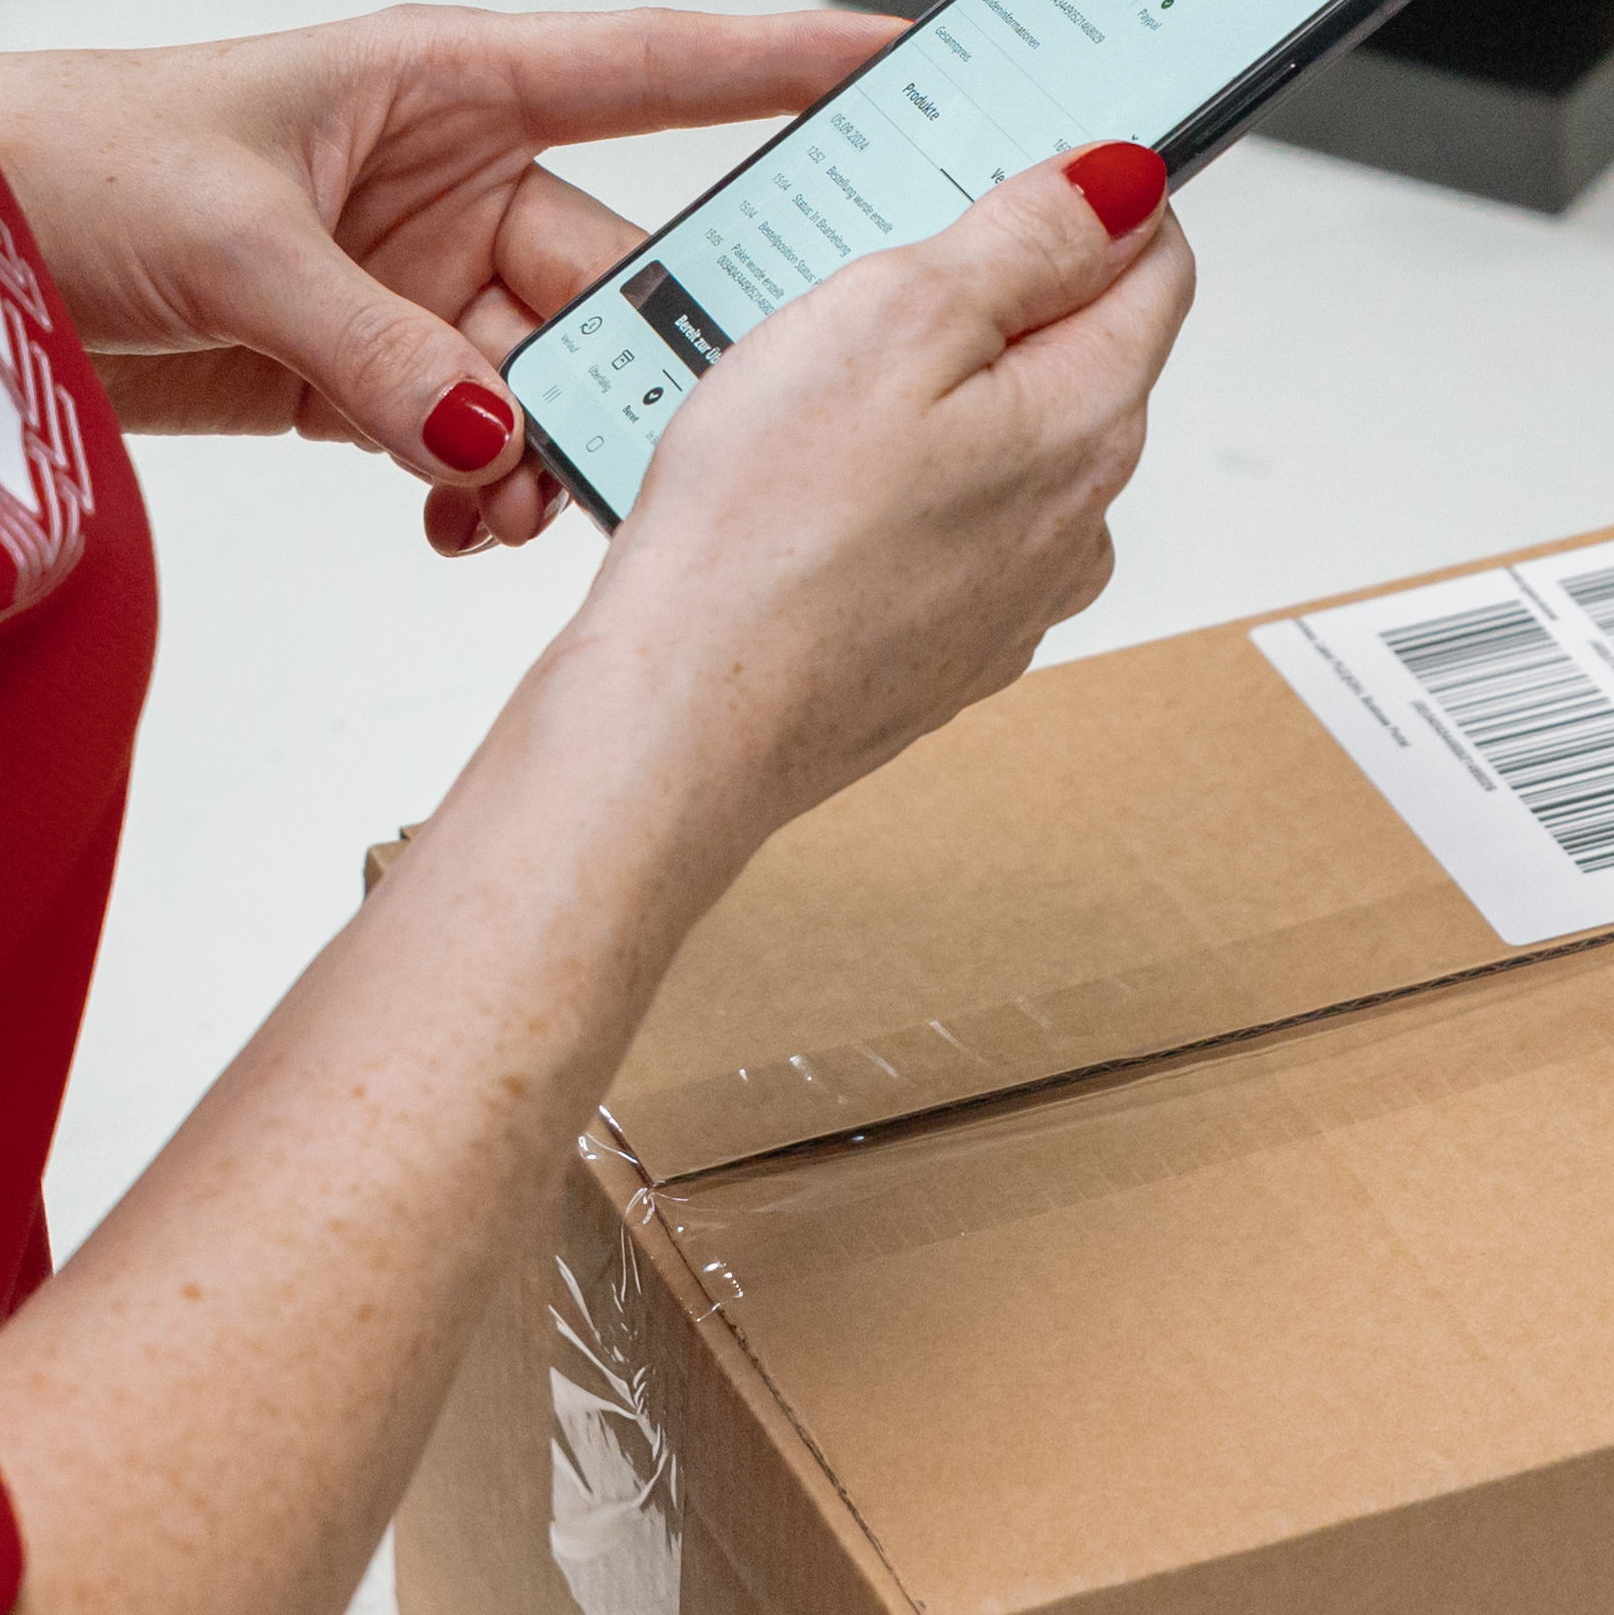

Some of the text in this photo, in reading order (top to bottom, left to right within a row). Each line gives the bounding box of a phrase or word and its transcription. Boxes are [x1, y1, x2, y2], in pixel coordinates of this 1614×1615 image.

[1136, 8, 1162, 30] Paypal
[934, 25, 971, 62] Gesamtpreis
[901, 82, 939, 121] Produkte
[830, 113, 869, 151] 05.09.2024
[825, 165, 856, 200] Bestellung
[852, 194, 873, 215] wurde
[988, 166, 1008, 185] Ve
[771, 172, 791, 191] 15:04
[808, 210, 820, 223] In
[815, 218, 851, 257] Bearbeitung
[730, 242, 750, 264] Paket
[745, 259, 765, 281] wurde
[757, 220, 798, 264] Bestellposition
[673, 312, 725, 366] Bereit zur Üb
[621, 404, 639, 423] Bereit
